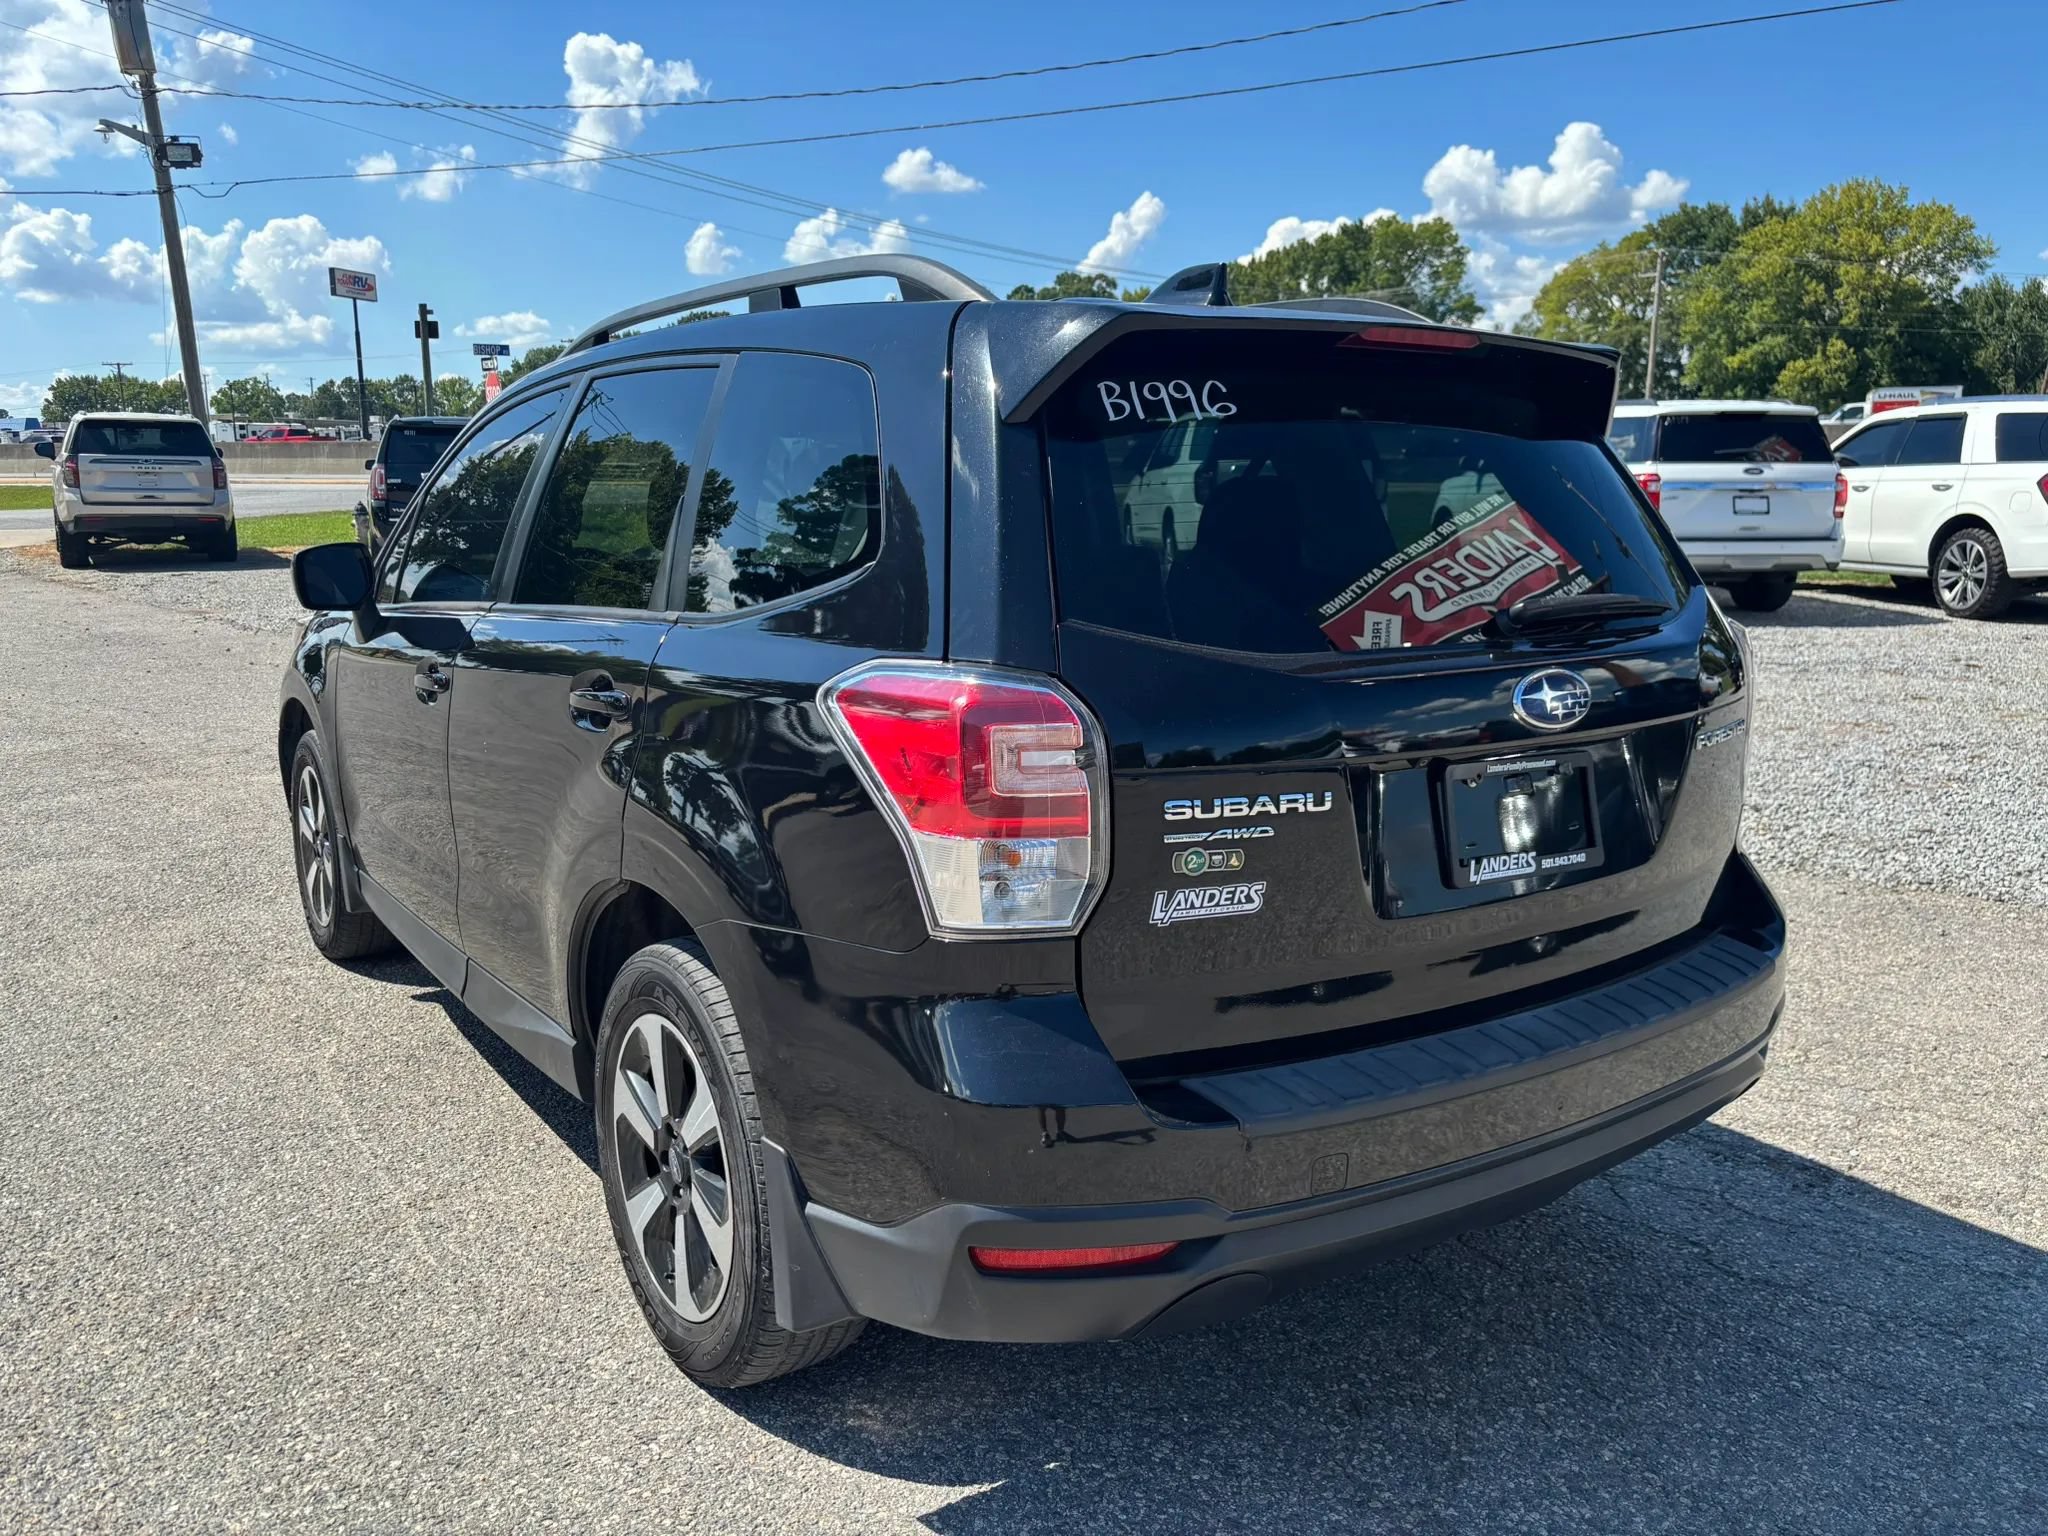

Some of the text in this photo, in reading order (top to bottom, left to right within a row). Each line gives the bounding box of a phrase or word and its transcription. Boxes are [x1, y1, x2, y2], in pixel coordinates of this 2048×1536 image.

[353, 275, 369, 289] RV
[473, 344, 501, 355] BISHOP
[1097, 379, 1238, 423] B1996
[1878, 391, 1917, 400] U-HAUL
[1163, 791, 1333, 822] SUBARU
[1206, 825, 1275, 842] AWD
[1186, 854, 1206, 870] 2nd
[1469, 851, 1537, 885] LANDERS
[1150, 881, 1267, 927] LANDERS
